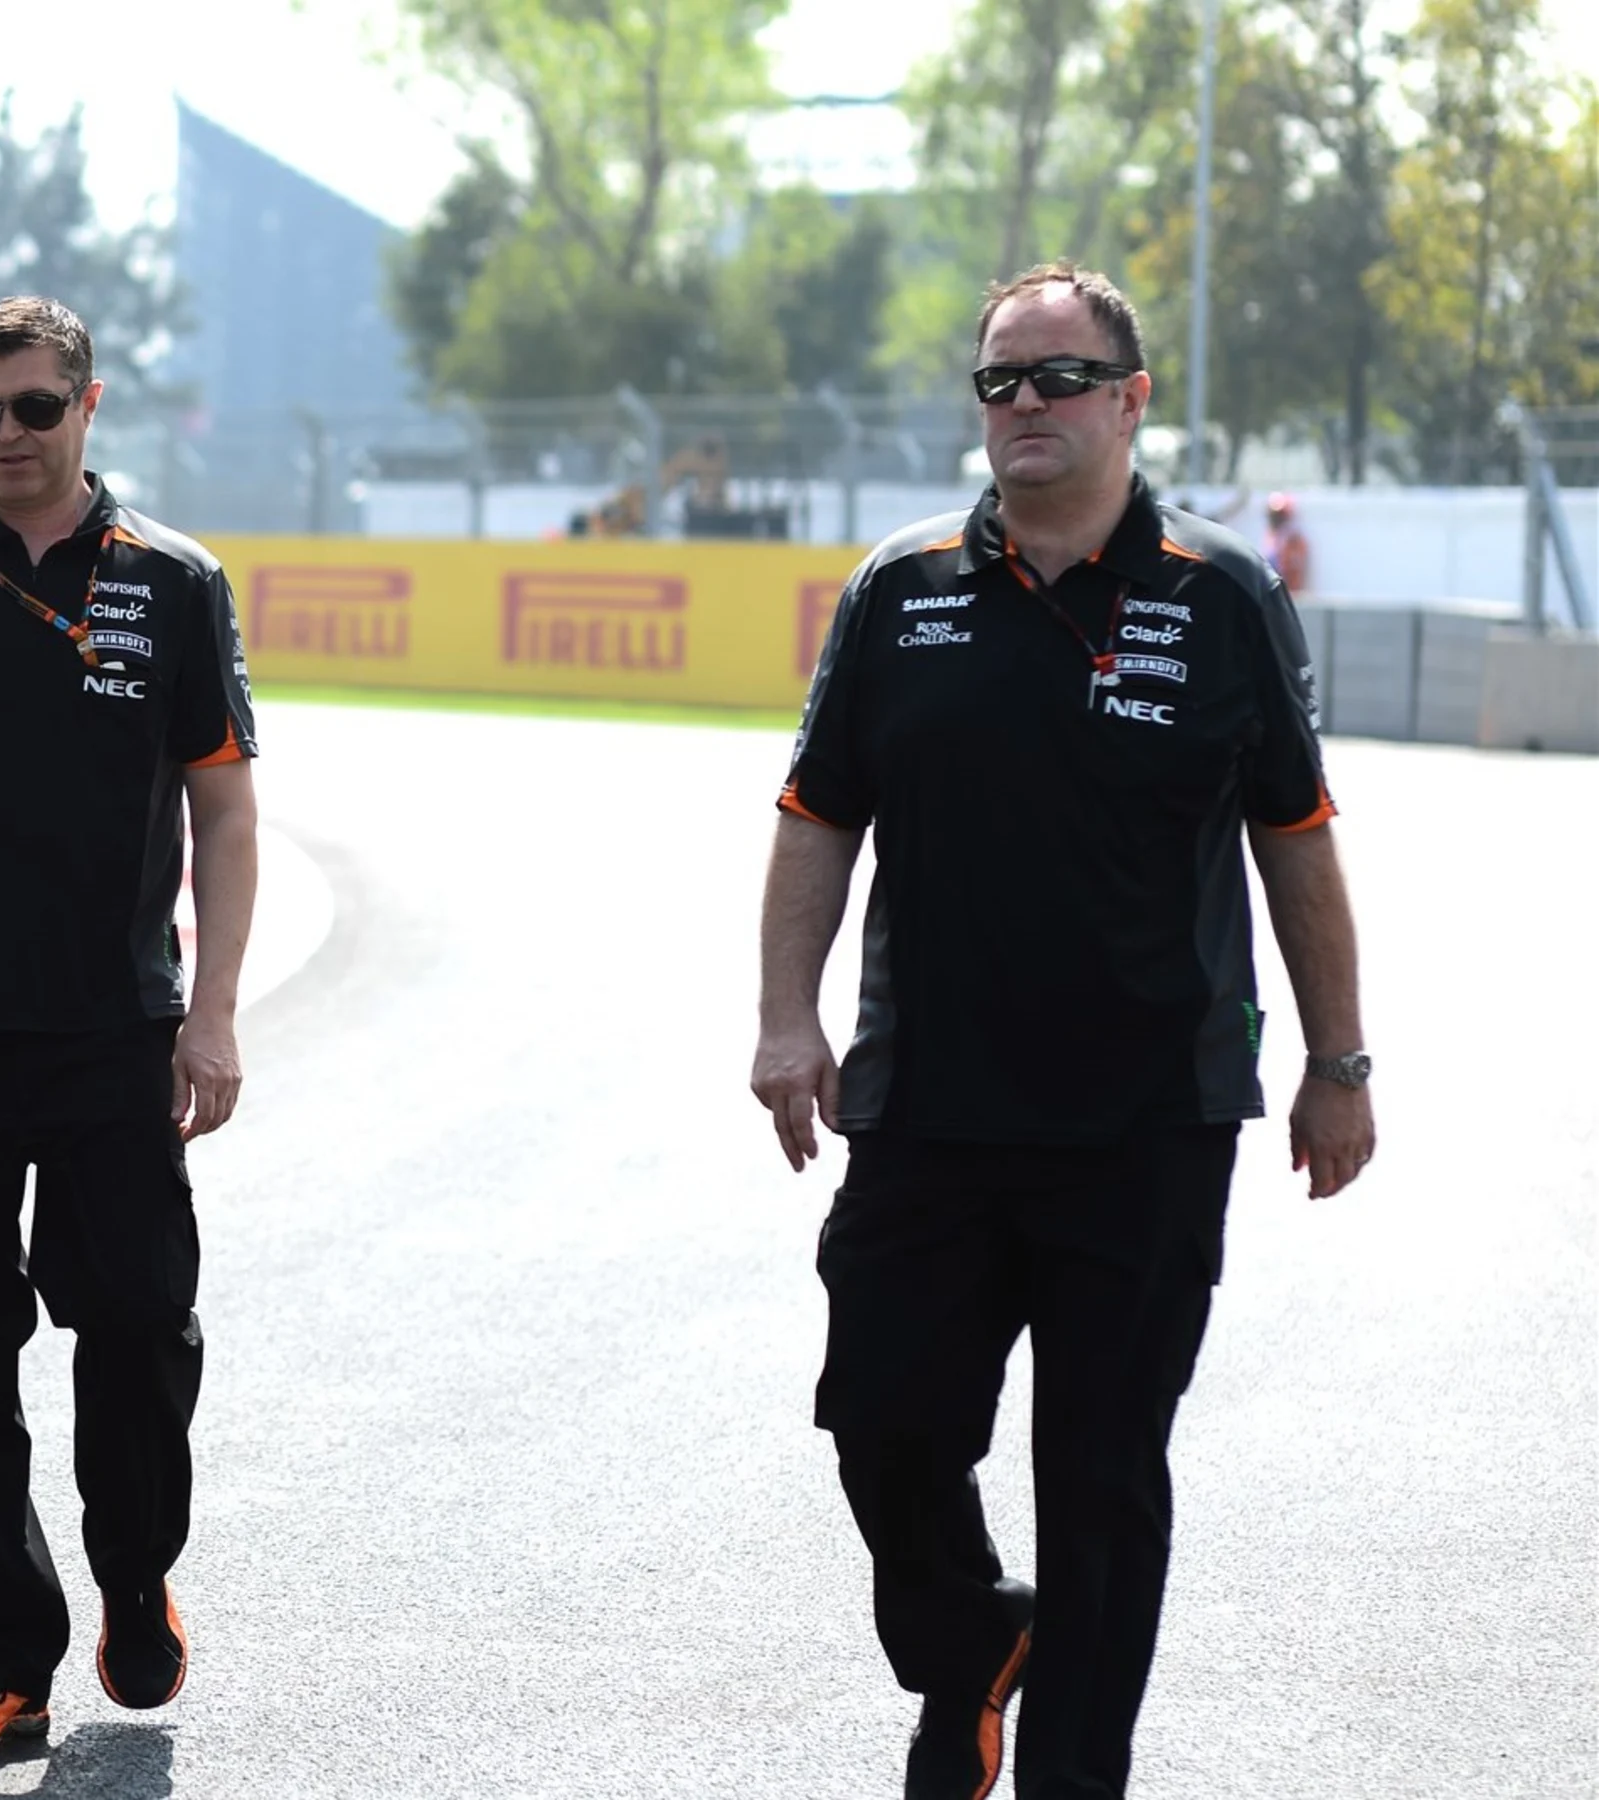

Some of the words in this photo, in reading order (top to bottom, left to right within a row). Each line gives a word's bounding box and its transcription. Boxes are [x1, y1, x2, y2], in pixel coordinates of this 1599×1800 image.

[91, 602, 140, 621] Claro
[248, 566, 412, 659] PIRELLI
[902, 595, 969, 612] SAHARA
[1123, 600, 1193, 622] KINGFISHER
[501, 572, 690, 674] PIRELLI
[916, 621, 955, 635] ROYAL
[898, 632, 973, 647] CHALLENGE
[1120, 624, 1176, 645] Claro
[83, 675, 146, 699] NEC
[1104, 696, 1175, 725] NEC
